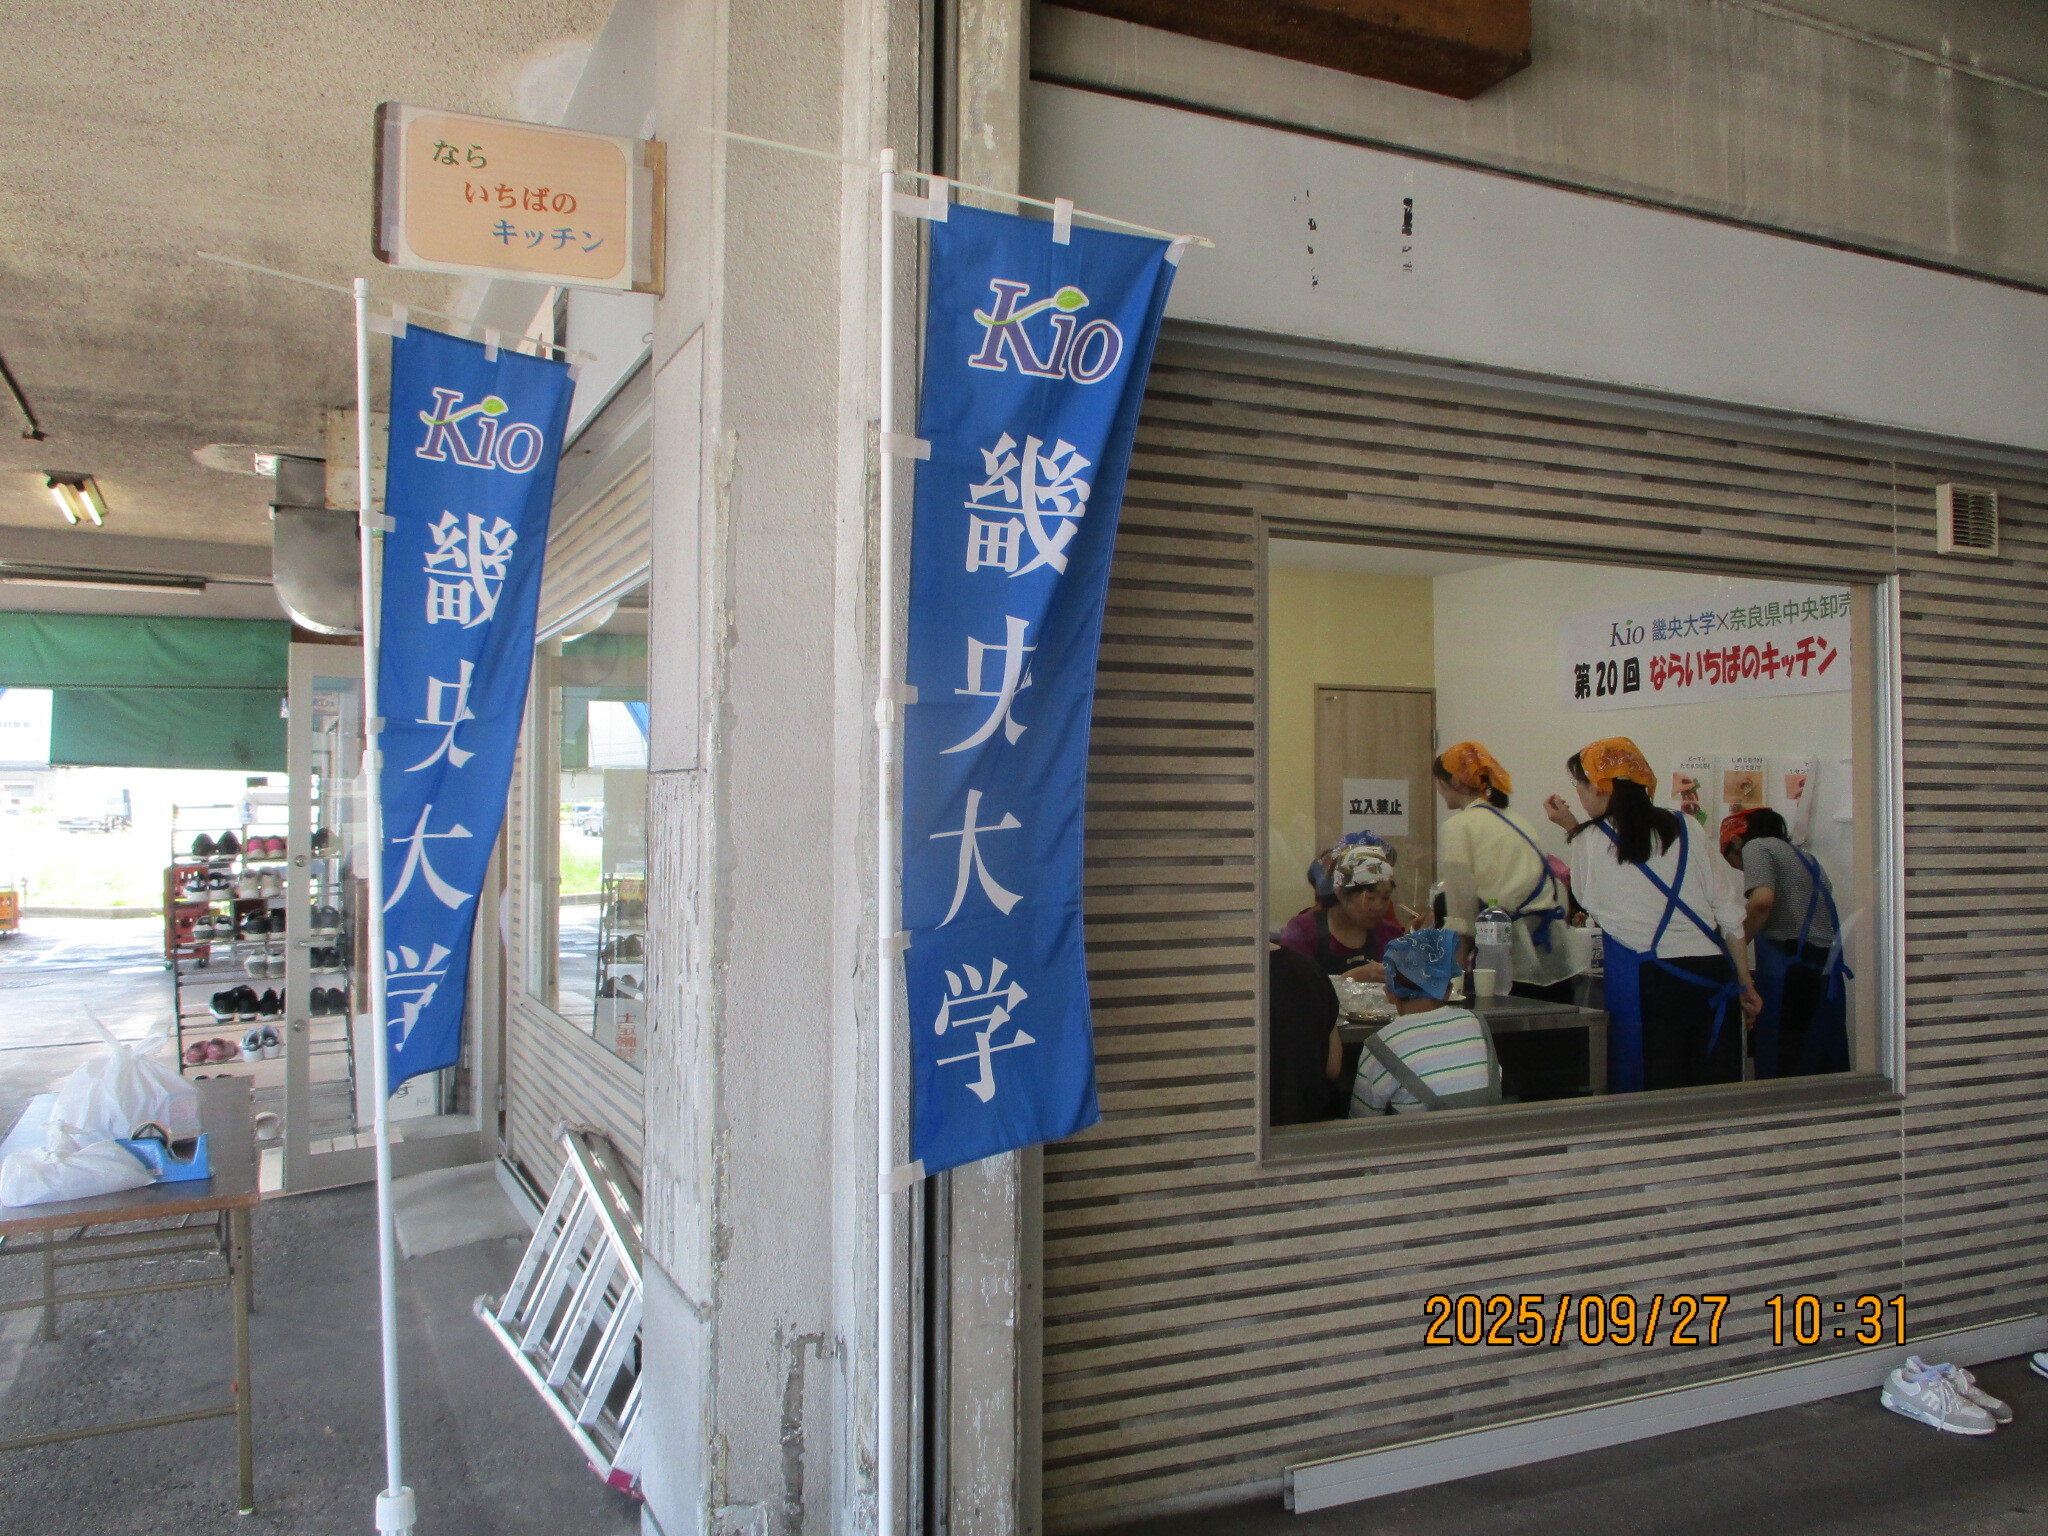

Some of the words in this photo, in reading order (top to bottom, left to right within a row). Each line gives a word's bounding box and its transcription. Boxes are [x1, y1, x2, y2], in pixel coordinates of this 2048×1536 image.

[432, 140, 488, 169] なら
[464, 181, 577, 215] いちばの
[492, 219, 604, 253] キッチン
[967, 278, 1123, 385] Kio
[415, 386, 544, 474] Kio
[1608, 618, 1645, 648] Kio
[1649, 635, 1838, 691] ならいちばのキッチン
[929, 431, 1092, 1104] 畿央大学
[1349, 798, 1403, 816] 立入禁止
